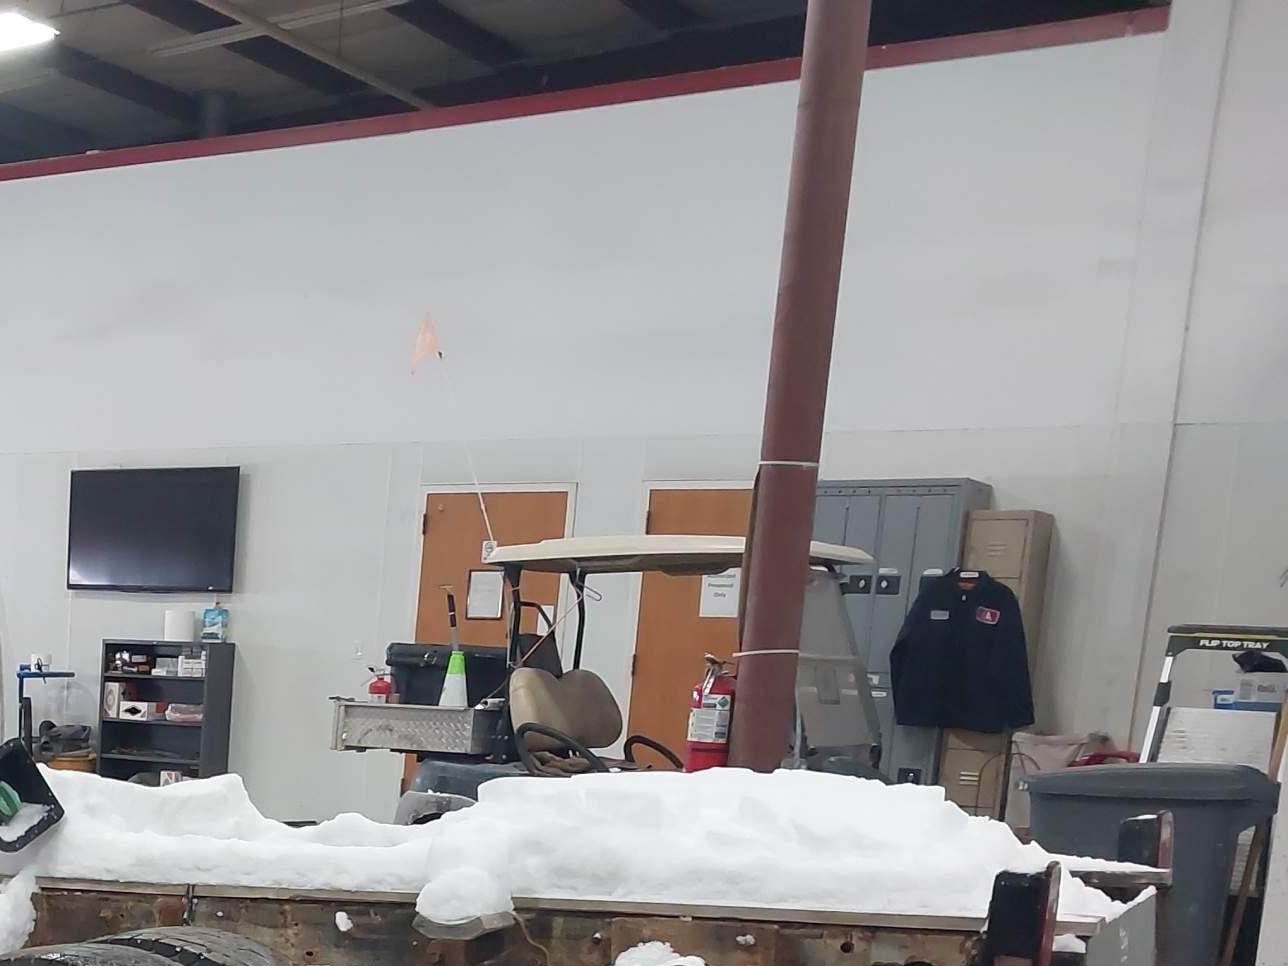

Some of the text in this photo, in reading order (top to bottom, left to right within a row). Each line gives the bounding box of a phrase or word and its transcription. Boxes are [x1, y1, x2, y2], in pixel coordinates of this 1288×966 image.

[1199, 639, 1270, 649] FLIP TOP TRAY
